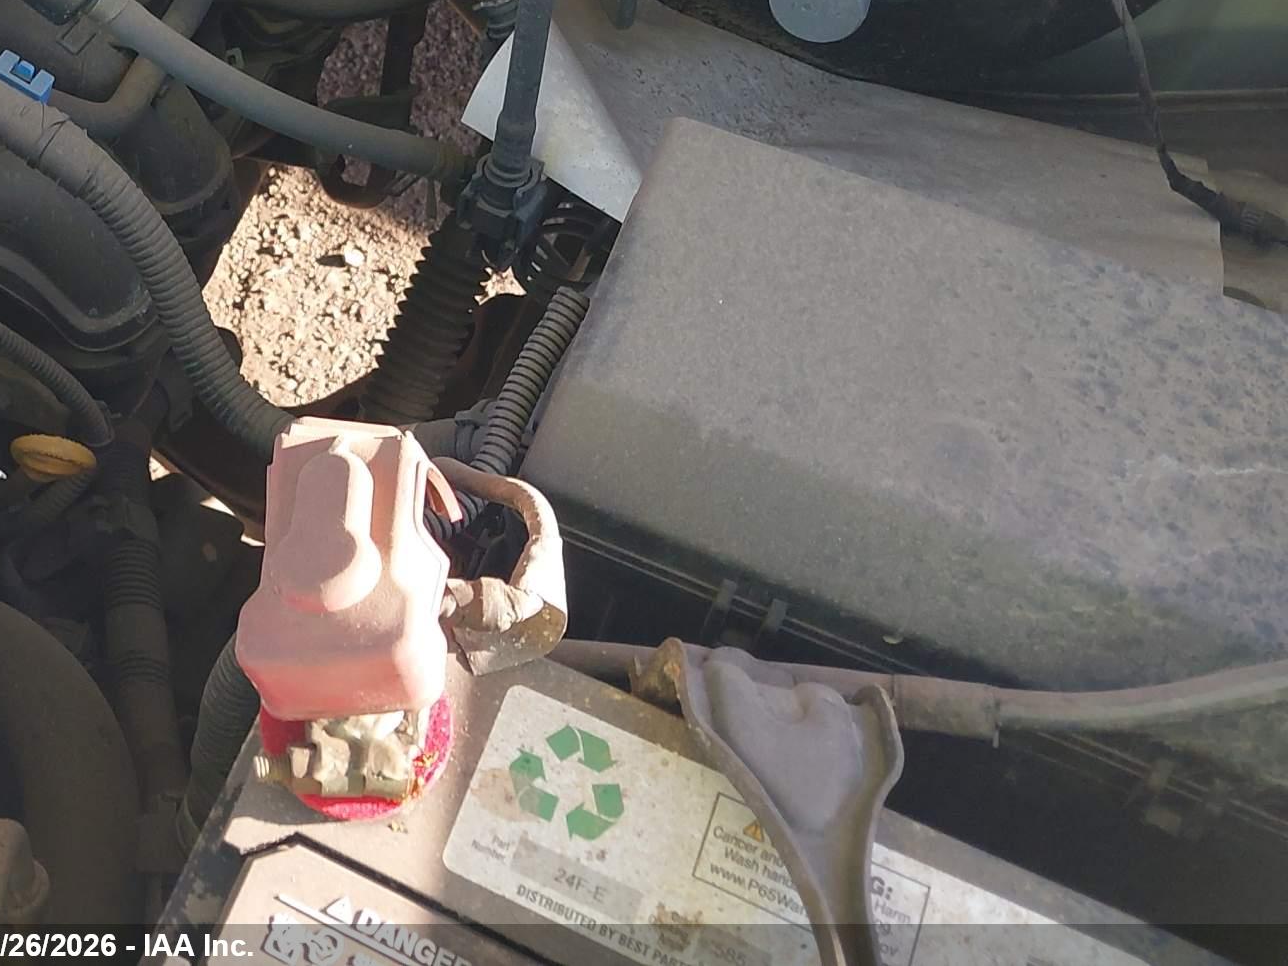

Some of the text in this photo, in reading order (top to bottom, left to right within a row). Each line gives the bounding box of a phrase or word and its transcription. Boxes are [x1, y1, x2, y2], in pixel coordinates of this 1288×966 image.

[713, 825, 759, 855] Cancer
[725, 845, 760, 874] Wash
[516, 883, 597, 933] DISTRIBUTED
[598, 923, 618, 942] BY
[618, 933, 651, 957] BEST
